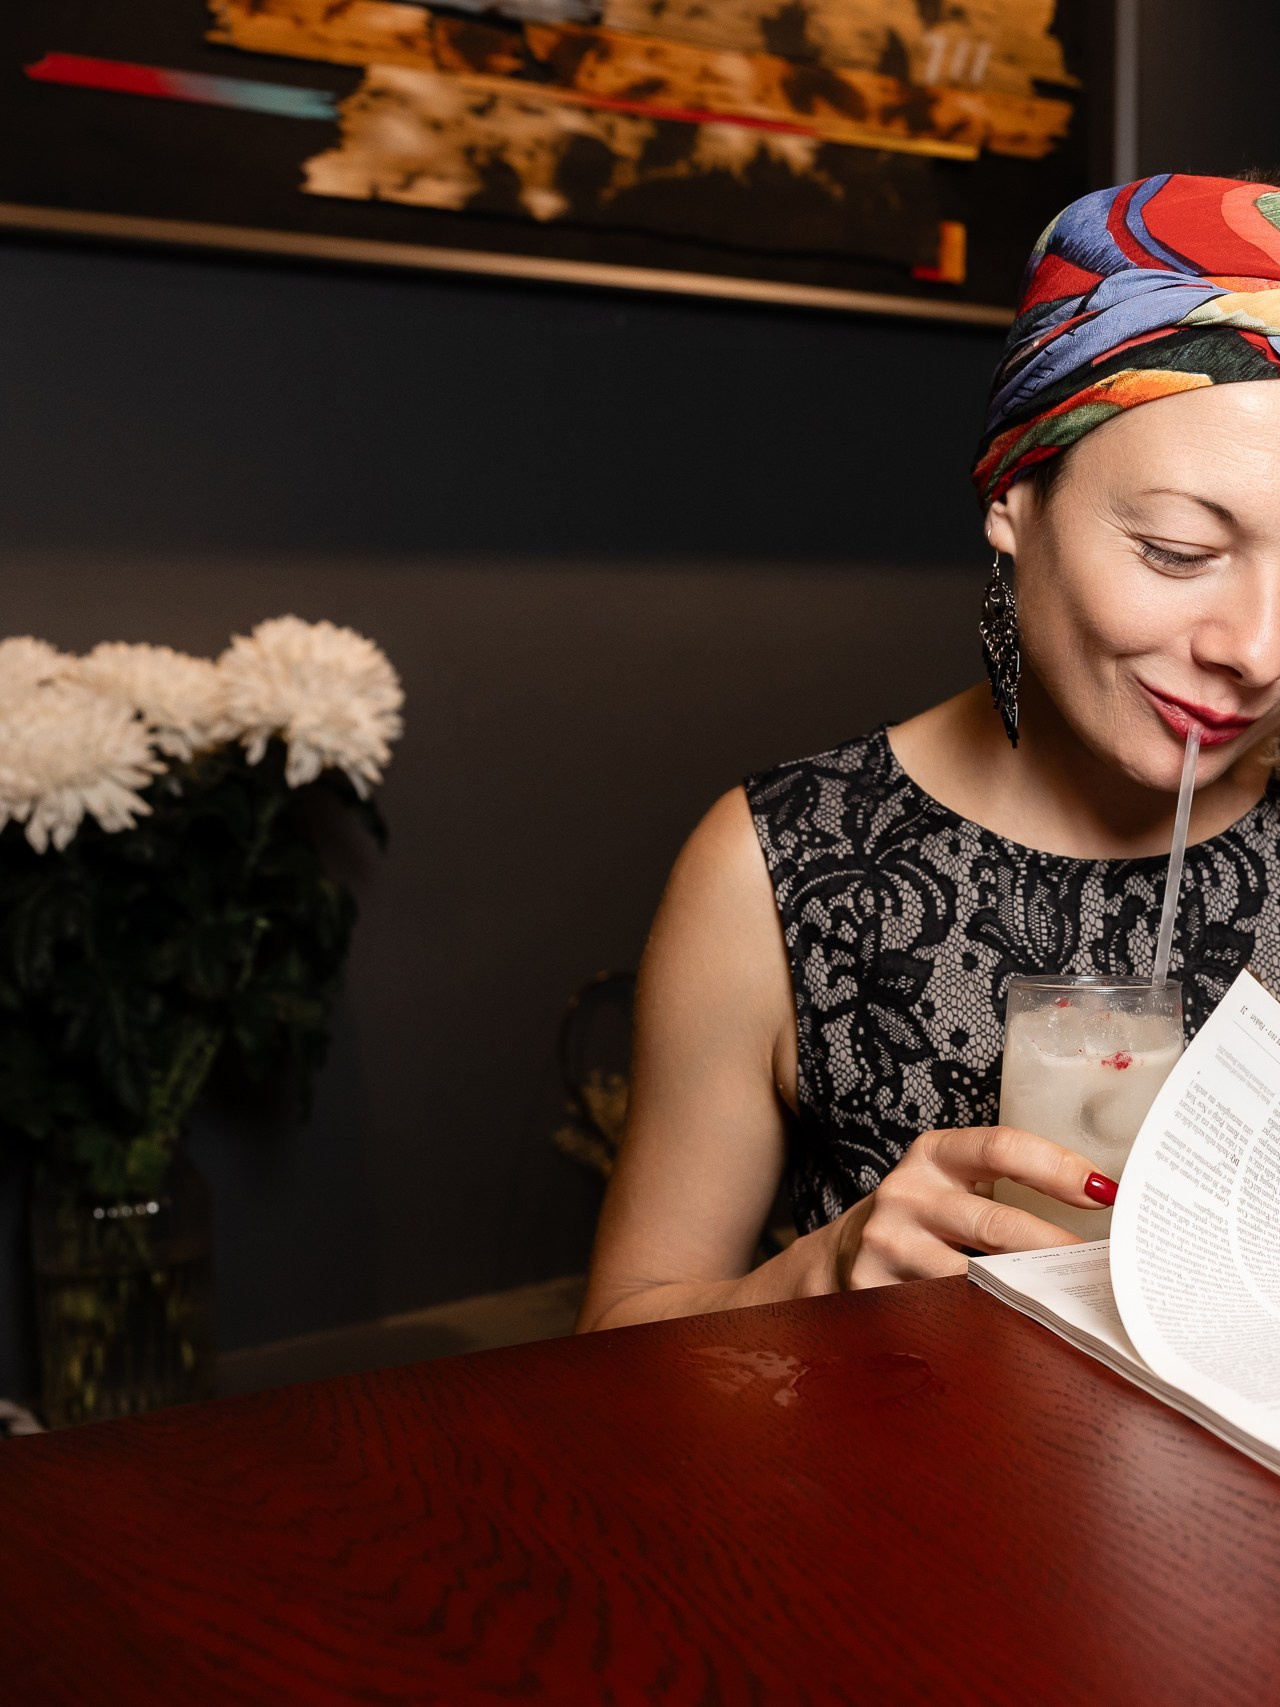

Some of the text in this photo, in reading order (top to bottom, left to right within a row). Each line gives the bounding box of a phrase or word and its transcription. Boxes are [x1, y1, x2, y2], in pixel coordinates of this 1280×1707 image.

[1239, 1004, 1248, 1015] 21
[1267, 1030, 1278, 1042] 2012
[1194, 1082, 1254, 1136] città meravigliose ma anche
[1178, 1099, 1225, 1141] di base era di cercare
[1186, 1089, 1249, 1145] non Roma, Parigi New York,
[1174, 1110, 1240, 1166] DQ: Anche nella scelta delle cit-
[1262, 1127, 1270, 1136] per
[1268, 1133, 1280, 1144] poco
[1162, 1130, 1186, 1150] altrettante
[1257, 1137, 1268, 1147] pro-
[1248, 1155, 1253, 1163] si
[1252, 1146, 1264, 1160] fuori
[1266, 1144, 1280, 1161] Sembra
[1184, 1160, 1194, 1168] qui
[1191, 1151, 1222, 1177] rappresentano
[1193, 1166, 1202, 1175] che
[1218, 1160, 1237, 1175] mostre?
[1154, 1150, 1229, 1207] Come avete lavorato alla scelta
[1202, 1172, 1213, 1182] città
[1246, 1164, 1258, 1181] Road,
[1264, 1167, 1276, 1180] della
[1226, 1177, 1234, 1185] no
[1242, 1176, 1254, 1190] Cen-
[1260, 1174, 1277, 1195] Nanjing
[1220, 1184, 1232, 1196] delle
[1254, 1184, 1262, 1194] del
[1262, 1190, 1274, 1201] piani
[1238, 1197, 1246, 1206] ab-
[1242, 1186, 1262, 1207] building
[1144, 1181, 1228, 1236] giusto, professionale, piacevole
[1236, 1206, 1248, 1218] Con
[1262, 1200, 1280, 1215] diversi
[1138, 1214, 1149, 1225] una
[1140, 1192, 1230, 1246] far accadere in modo
[1139, 1203, 1232, 1254] mostra ma lavorare insieme per
[1150, 1221, 1170, 1236] curare
[1236, 1217, 1278, 1240] che rappresen-
[1177, 1235, 1190, 1246] solo
[1236, 1226, 1274, 1246] solo ufficiale
[1238, 1236, 1260, 1248] enorme
[1136, 1235, 1208, 1270] confermare con fatti
[1137, 1224, 1238, 1270] come ancora possibile arte
[1220, 1254, 1234, 1263] non
